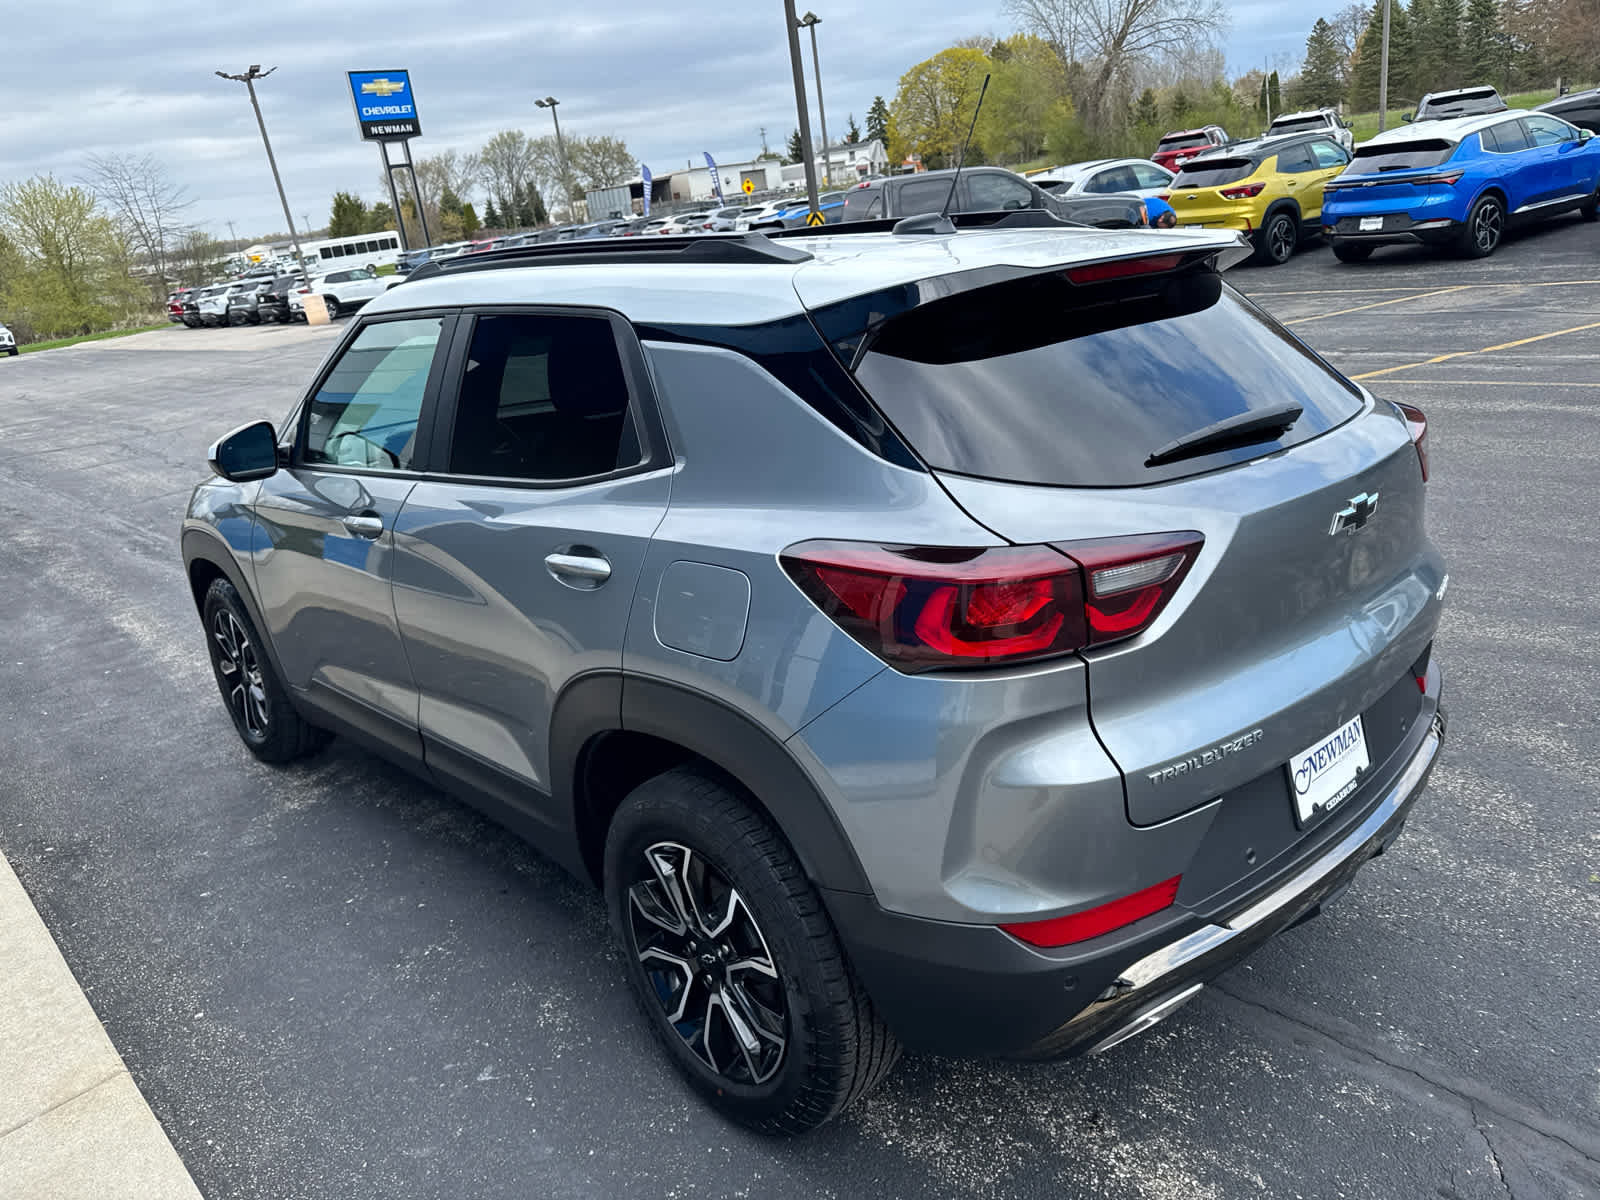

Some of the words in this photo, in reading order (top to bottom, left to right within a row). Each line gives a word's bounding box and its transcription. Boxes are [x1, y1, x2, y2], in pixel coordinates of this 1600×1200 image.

[362, 105, 412, 116] CHEVROLET
[370, 124, 413, 135] NEWMAN
[1148, 729, 1264, 784] TRAILBLAZER
[1295, 718, 1361, 795] NEWMAN
